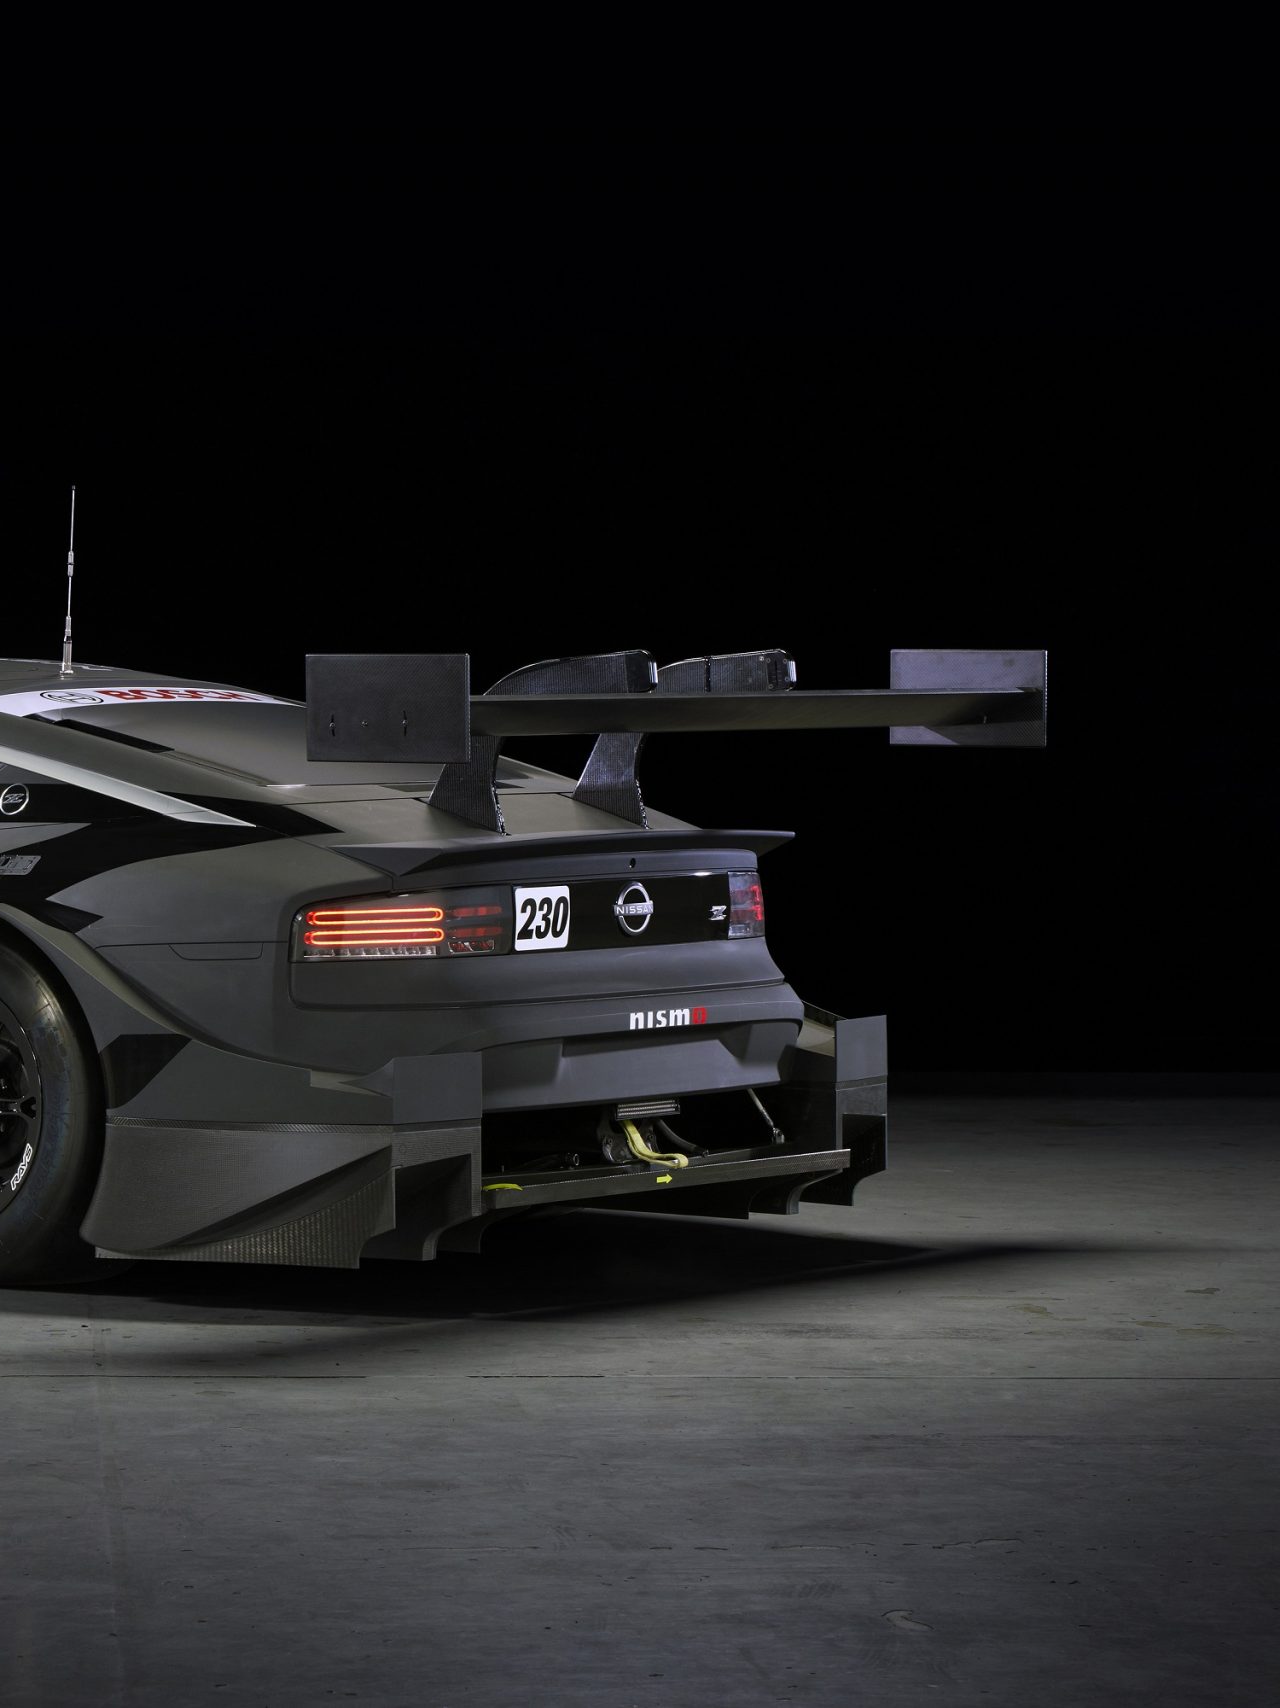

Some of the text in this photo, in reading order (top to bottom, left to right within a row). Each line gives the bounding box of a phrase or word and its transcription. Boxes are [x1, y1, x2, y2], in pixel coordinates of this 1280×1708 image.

[94, 689, 263, 701] BOSCH
[516, 895, 569, 941] 230
[615, 903, 654, 916] NISSAN
[629, 1006, 708, 1031] nismo
[10, 1143, 33, 1191] RAYS
